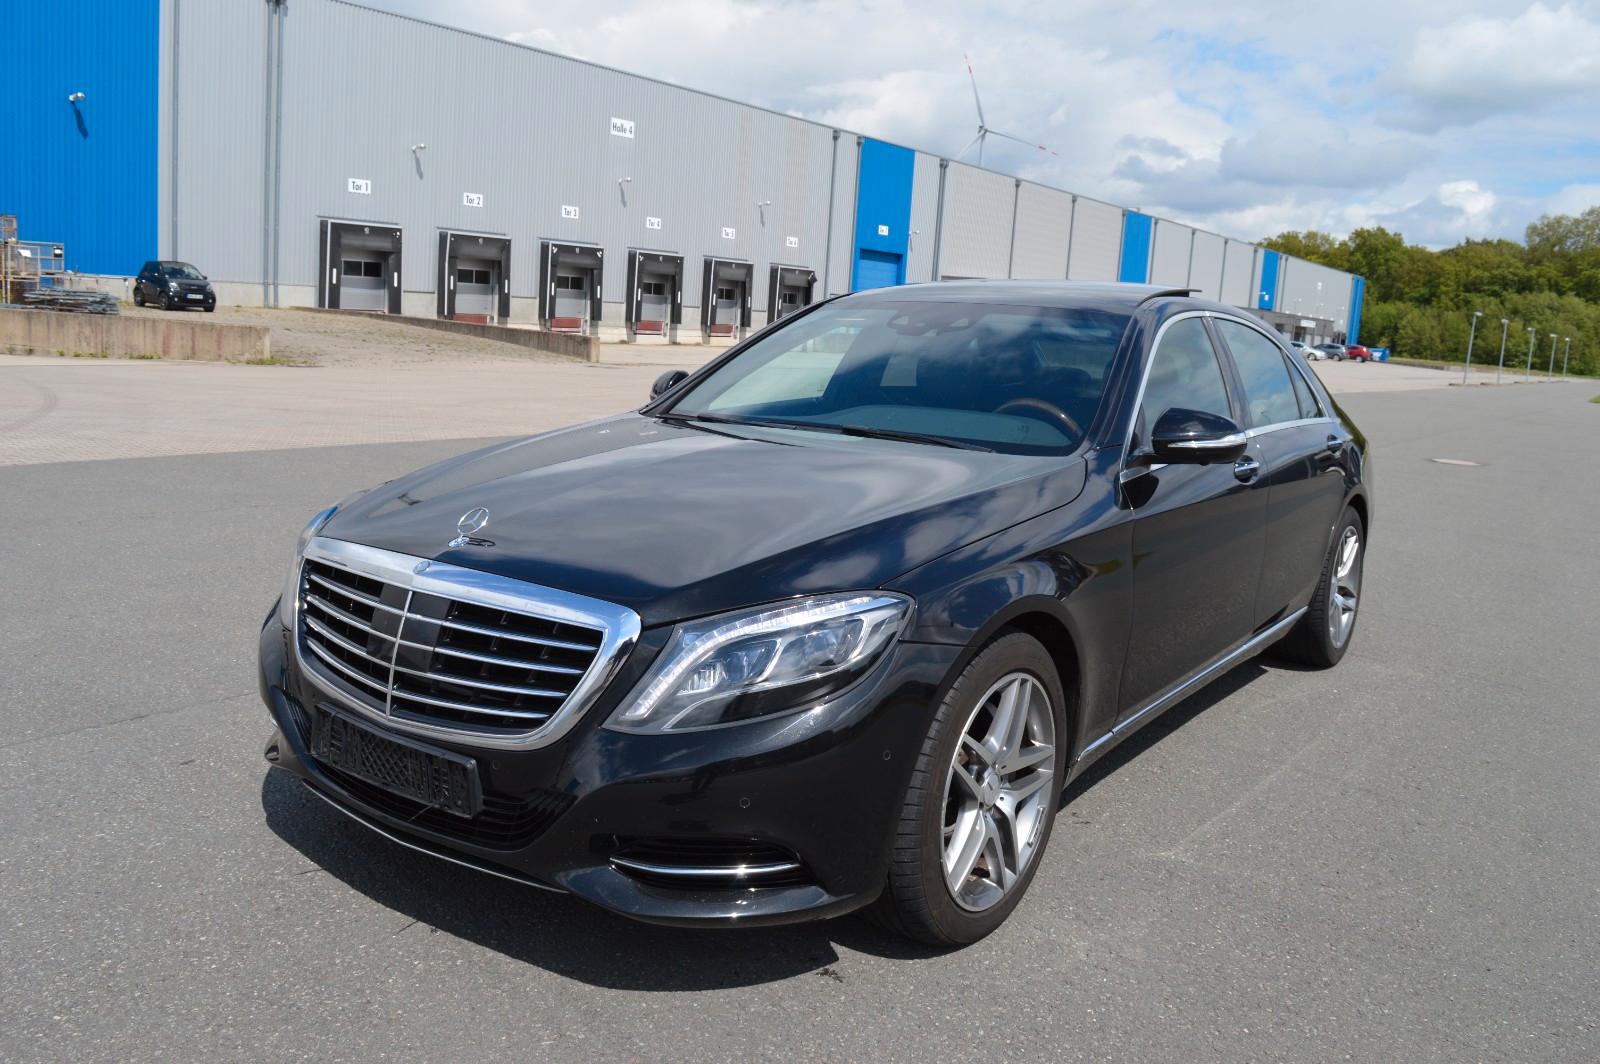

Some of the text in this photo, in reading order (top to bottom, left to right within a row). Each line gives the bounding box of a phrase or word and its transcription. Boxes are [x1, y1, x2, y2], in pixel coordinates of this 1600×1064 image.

[612, 122, 633, 135] Halle 4
[352, 181, 362, 191] Tor
[466, 195, 481, 205] Tor 2
[564, 208, 577, 217] Tor 3
